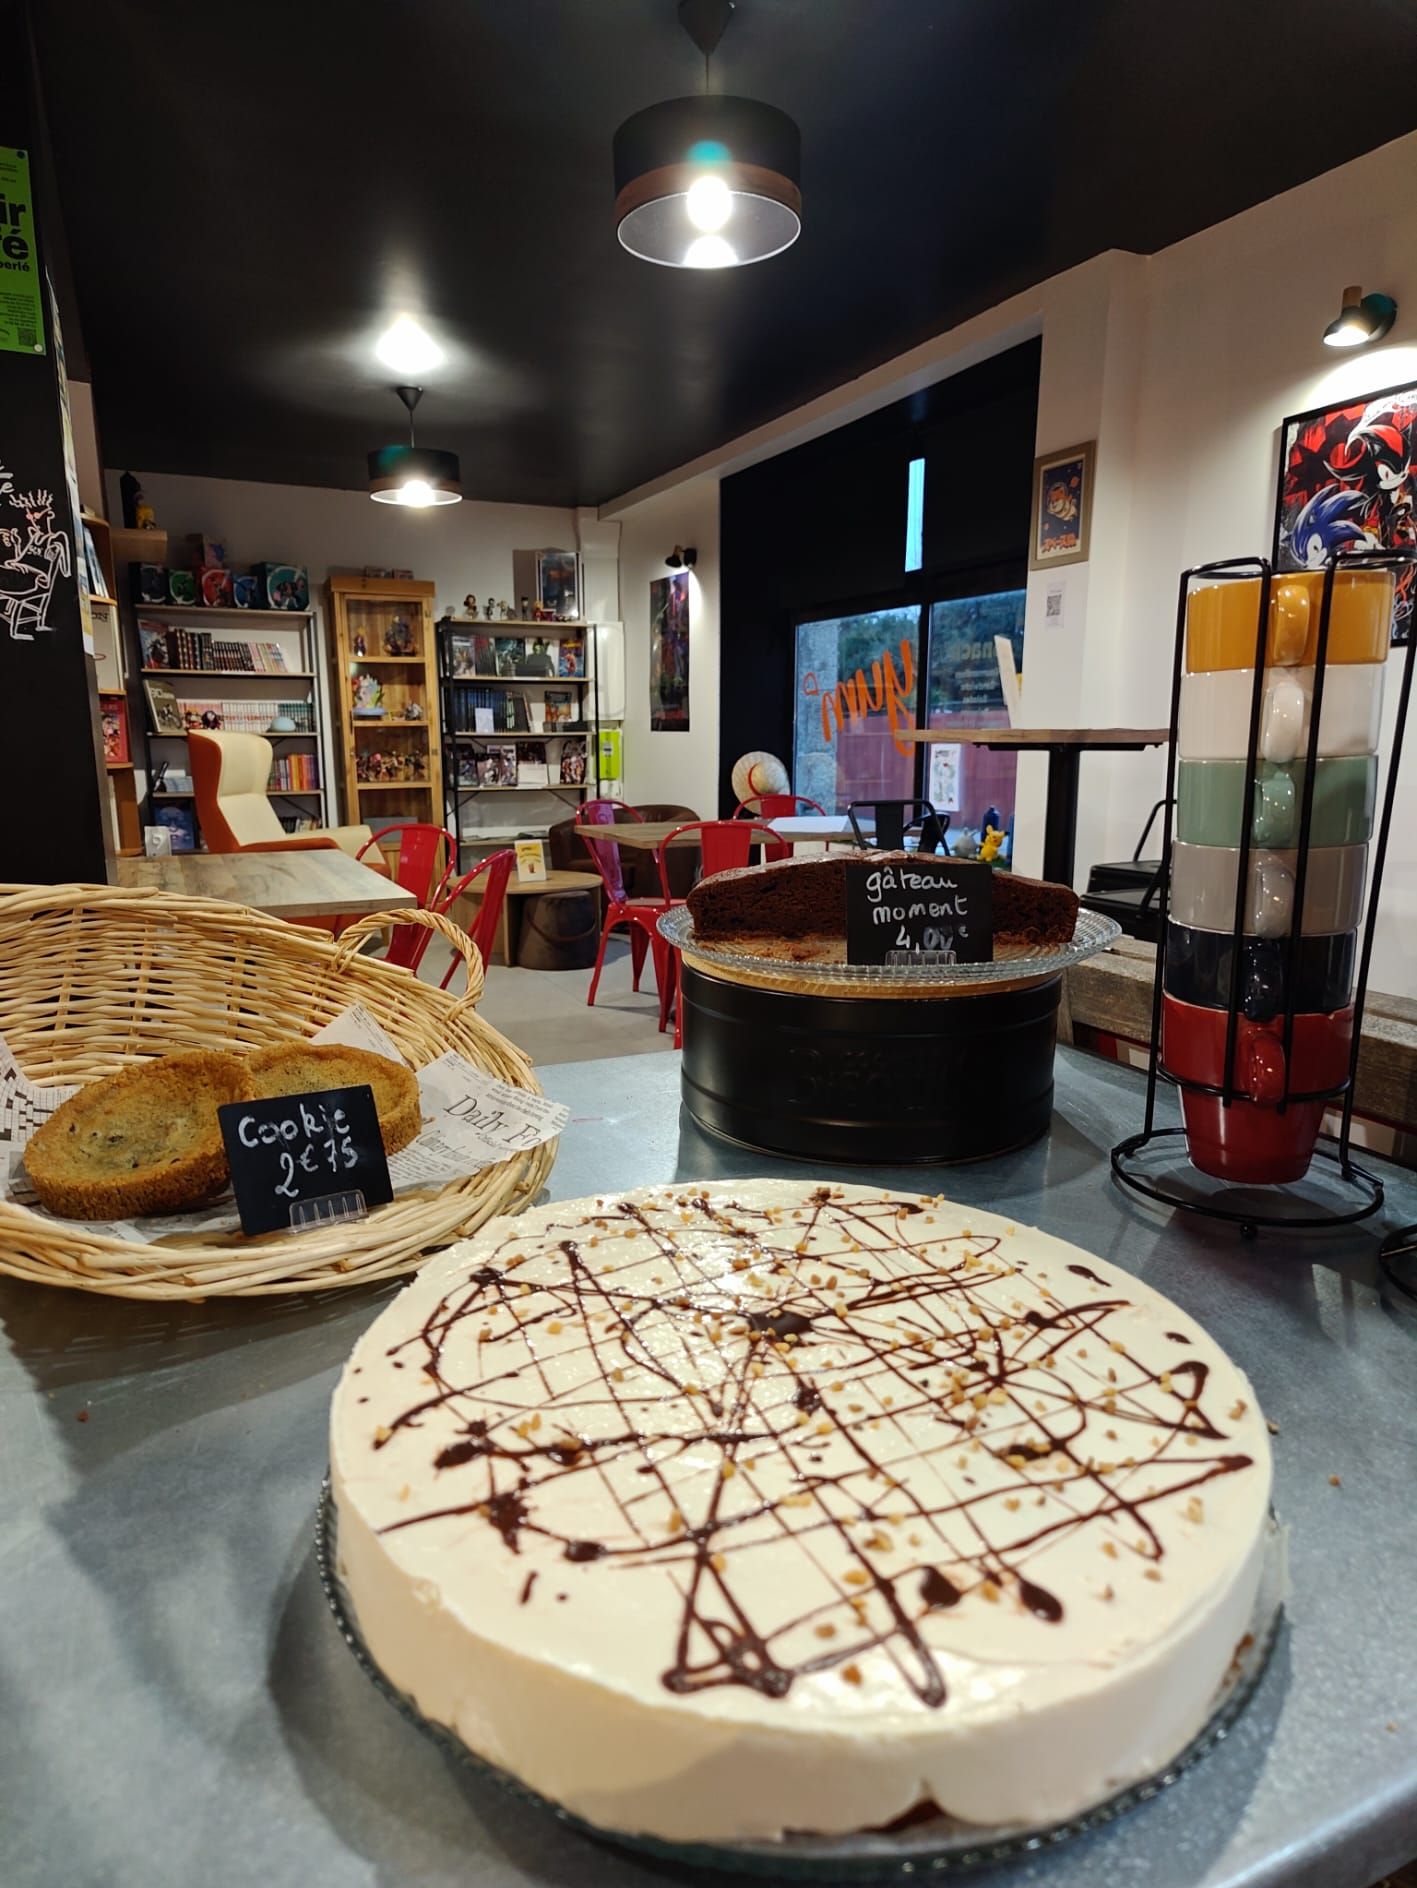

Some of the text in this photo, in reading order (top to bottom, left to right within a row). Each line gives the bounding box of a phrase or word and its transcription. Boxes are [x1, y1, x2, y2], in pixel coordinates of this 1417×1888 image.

[866, 866, 958, 902] gâteau
[873, 894, 968, 925] moment
[238, 1103, 350, 1148] Cookie
[442, 1094, 509, 1133] Daily
